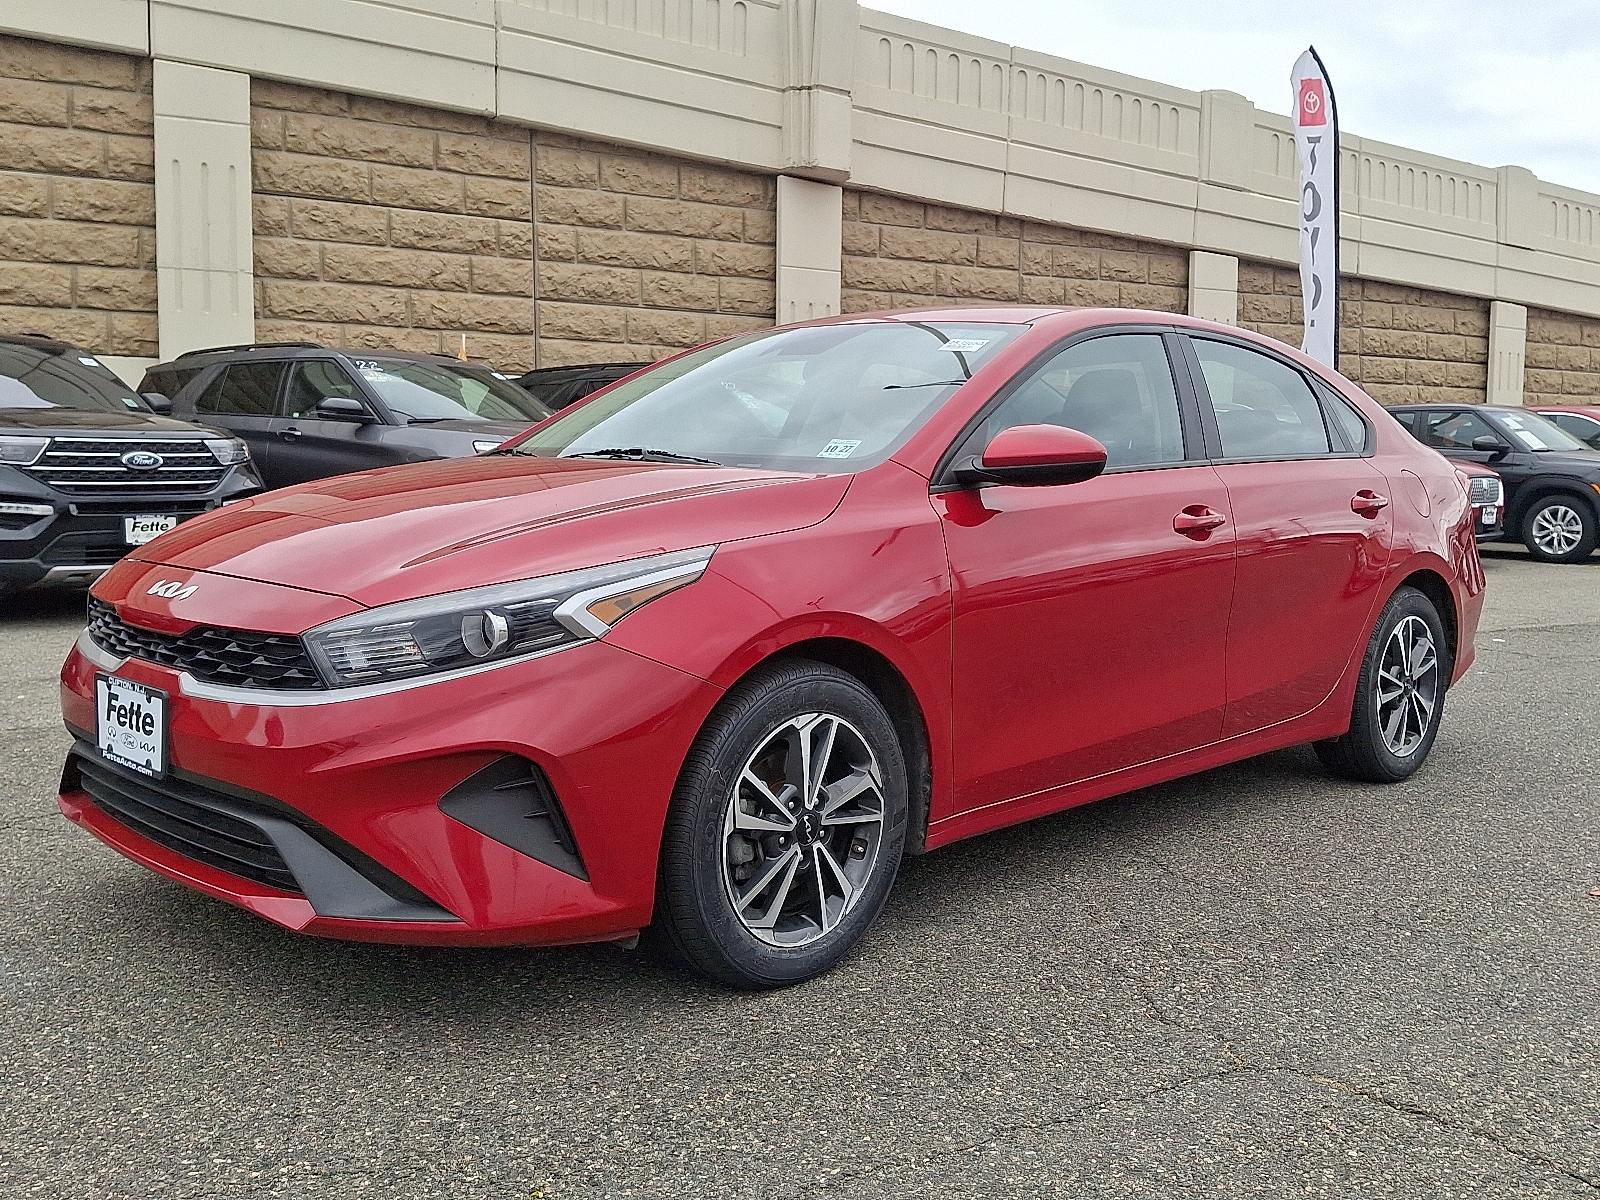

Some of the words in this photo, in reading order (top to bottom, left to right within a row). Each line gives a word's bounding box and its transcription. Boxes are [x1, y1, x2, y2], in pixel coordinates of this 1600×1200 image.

[1302, 136, 1322, 356] TOY
[825, 445, 838, 453] 10
[839, 445, 855, 453] 27
[132, 455, 156, 466] Ford
[131, 521, 169, 533] Fette
[147, 579, 199, 601] KIA
[106, 691, 155, 737] Fette
[102, 750, 153, 777] FetteAuto.com
